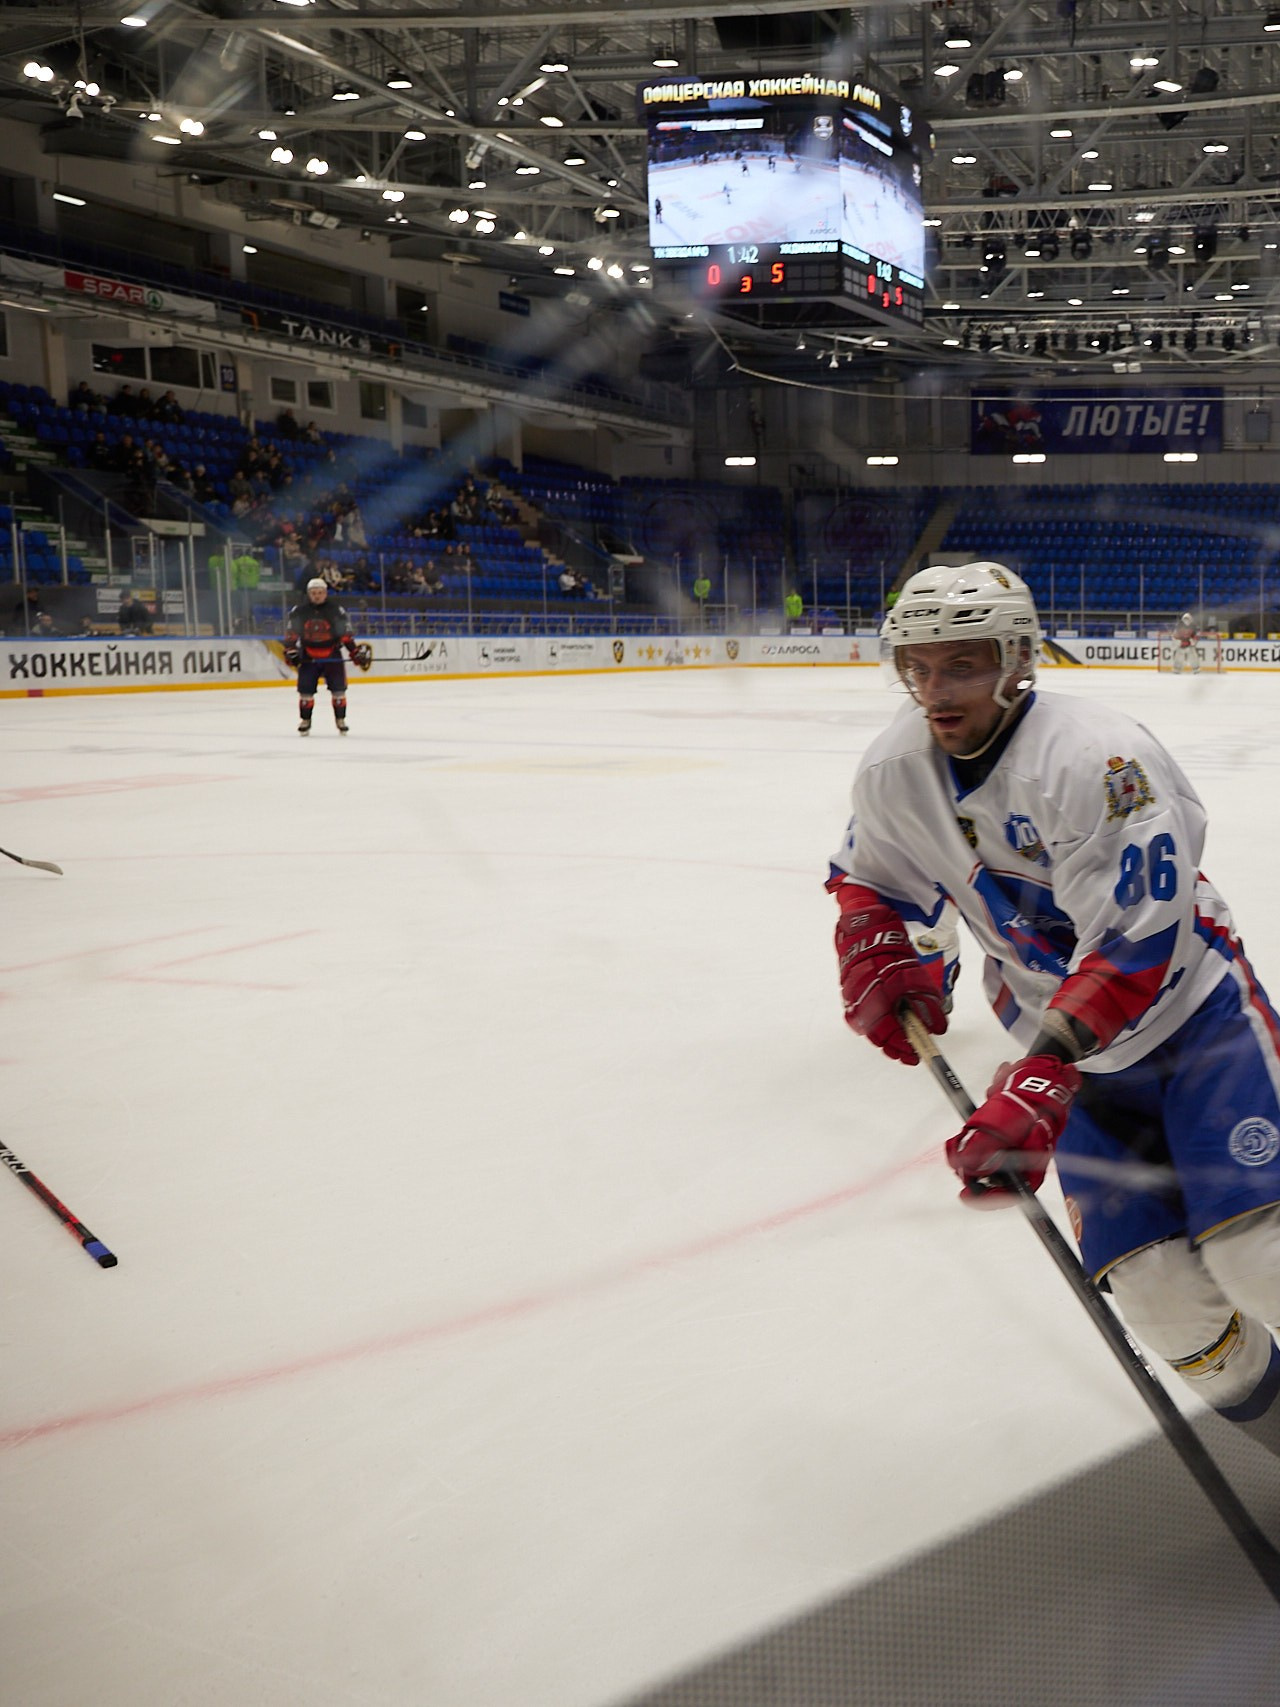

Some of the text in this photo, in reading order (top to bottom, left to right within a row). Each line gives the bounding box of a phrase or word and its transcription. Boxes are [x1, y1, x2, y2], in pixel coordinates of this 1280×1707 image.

[643, 73, 882, 110] ОФИЦЕРСКАЯ ХОККЕЙНАЯ ЛИГА
[727, 246, 760, 264] 1:42
[707, 264, 721, 286] 0
[740, 275, 752, 293] 3
[771, 263, 784, 284] 5
[82, 278, 145, 302] SPAR
[281, 319, 353, 347] TANK
[1062, 404, 1210, 436] ЛЮТЫЕ!
[903, 607, 941, 619] CCM
[401, 640, 448, 660] ЛИА
[1086, 645, 1205, 663] ОФИЦЕРСЯ
[9, 645, 241, 679] ХОККЕЙНАЯ ЛИГА
[1114, 832, 1178, 911] 86
